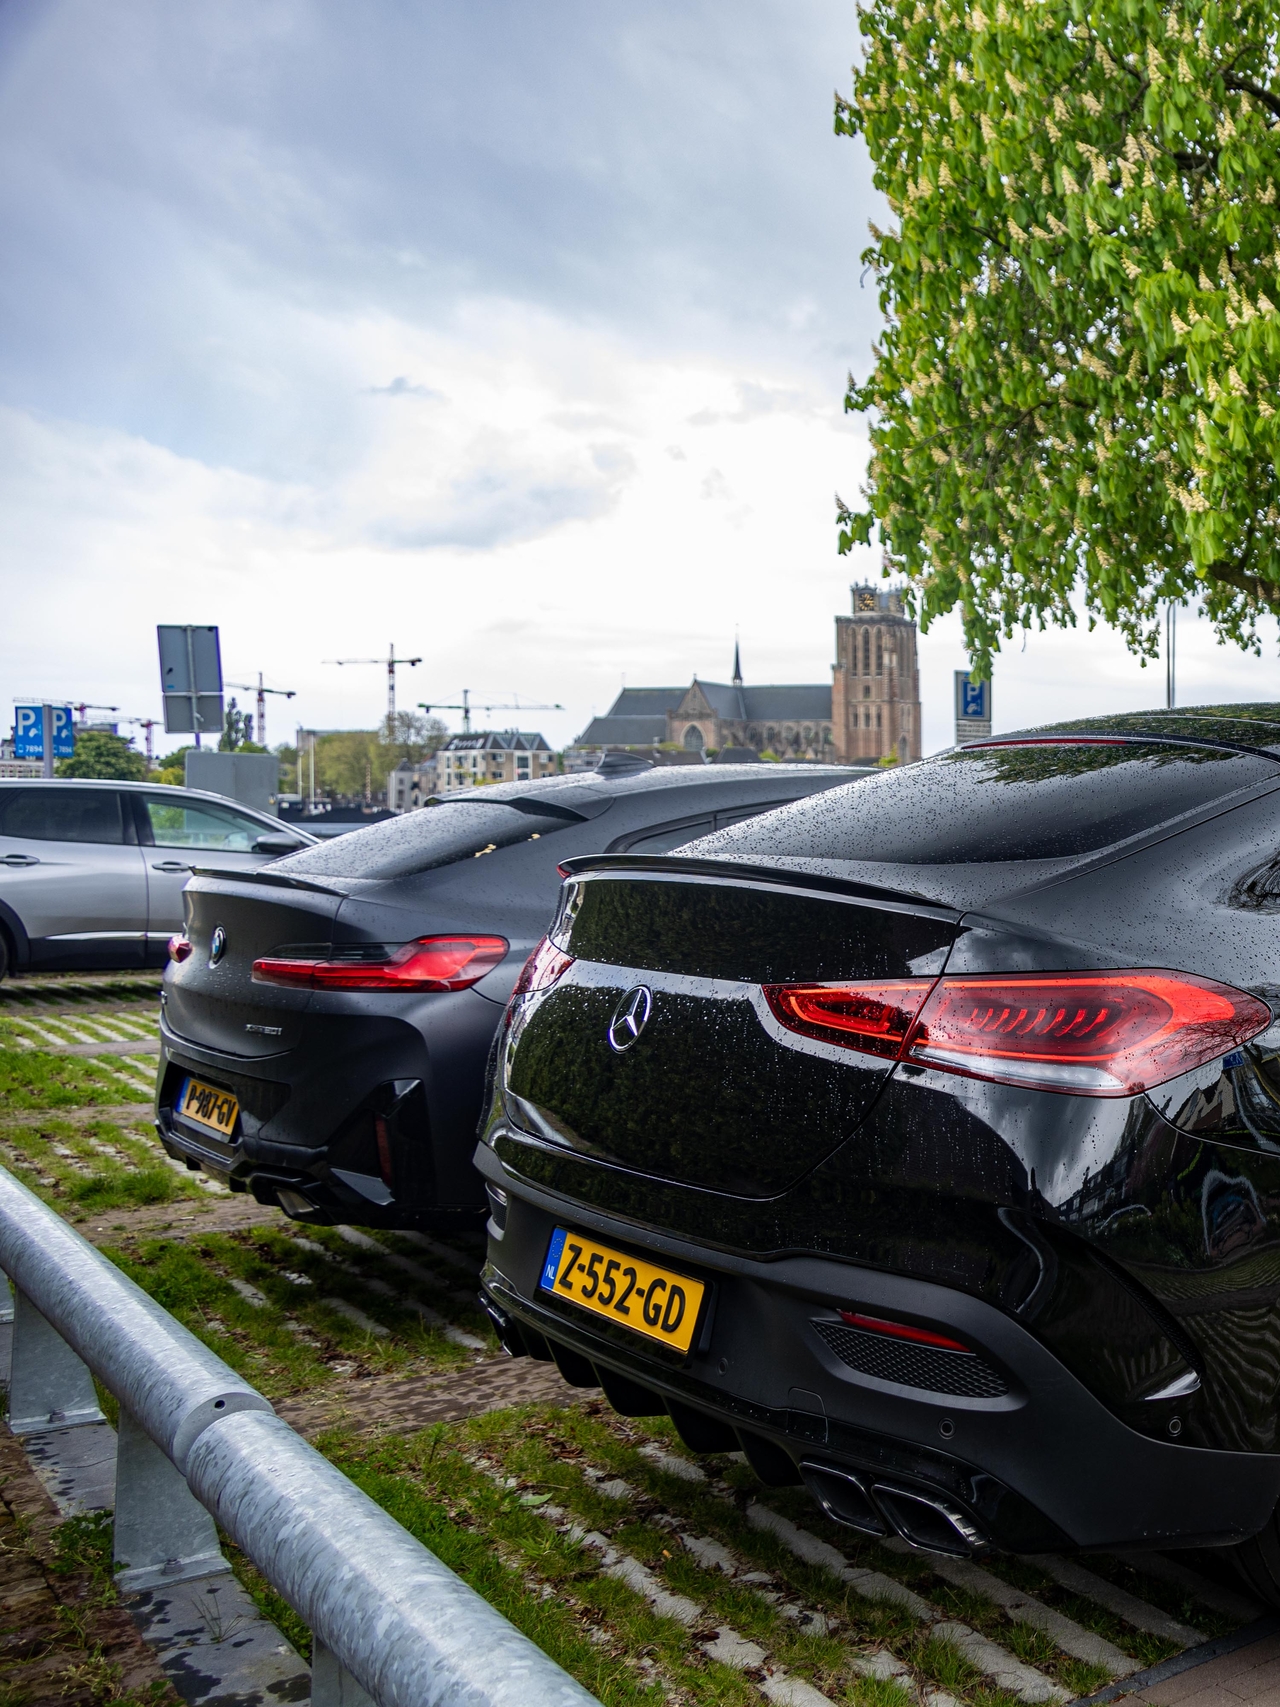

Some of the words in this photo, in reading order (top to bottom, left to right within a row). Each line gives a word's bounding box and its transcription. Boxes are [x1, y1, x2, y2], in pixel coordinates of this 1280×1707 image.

[966, 683, 980, 701] P
[17, 708, 36, 736] P
[52, 709, 67, 736] P
[25, 744, 43, 753] 7894
[185, 1084, 237, 1127] P-987-GV
[545, 1263, 555, 1280] NL
[558, 1243, 686, 1333] Z-552-GD
